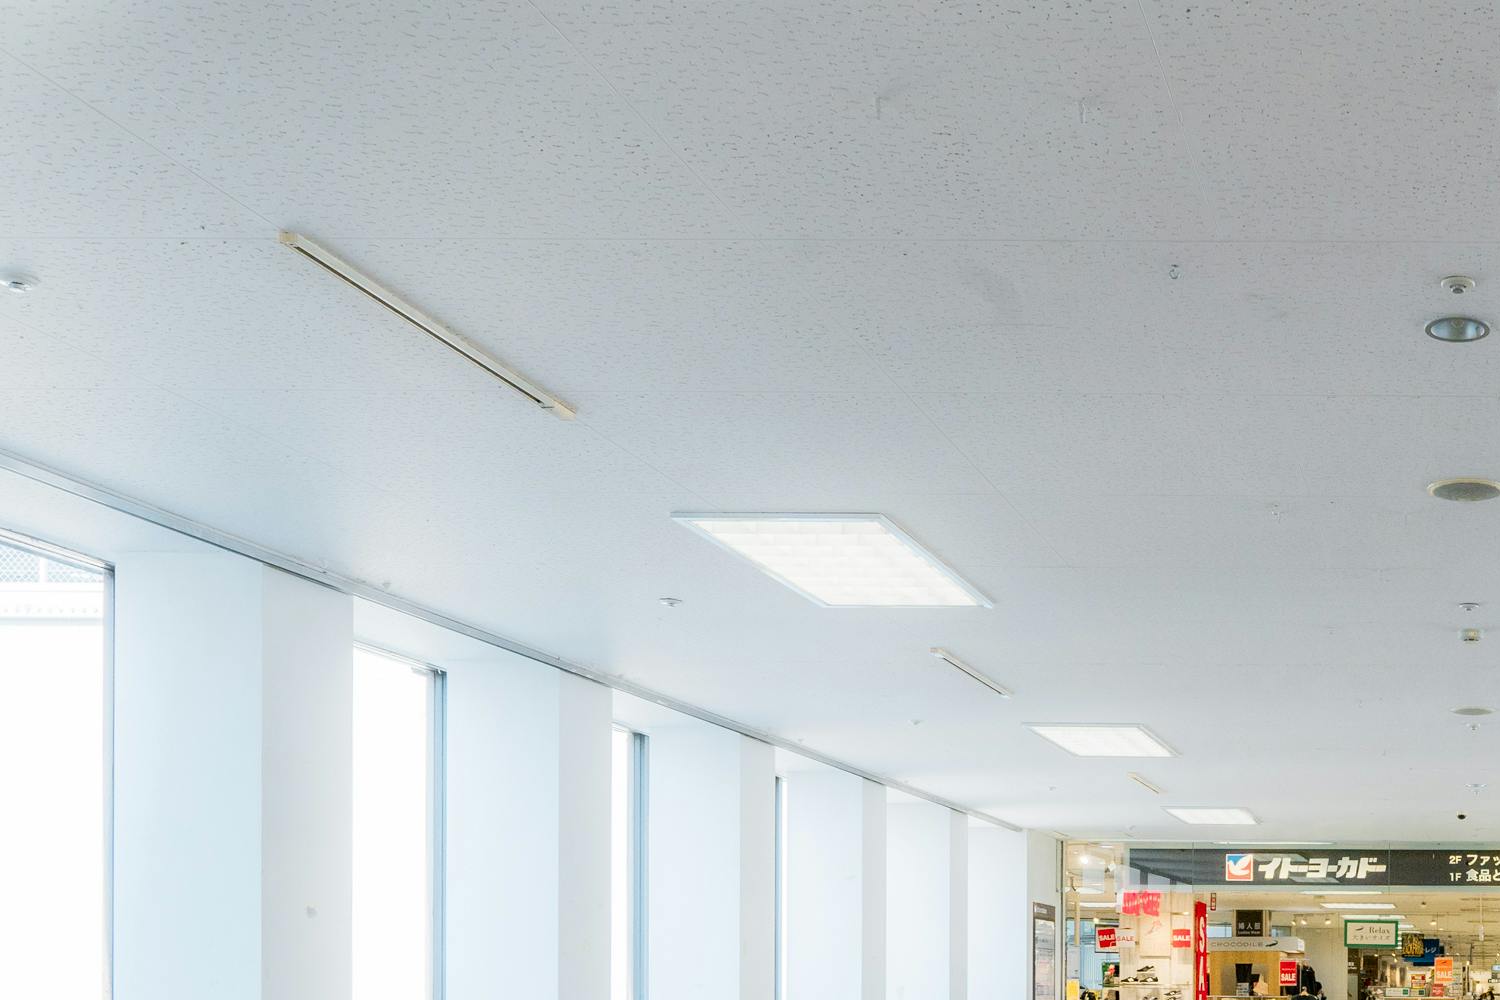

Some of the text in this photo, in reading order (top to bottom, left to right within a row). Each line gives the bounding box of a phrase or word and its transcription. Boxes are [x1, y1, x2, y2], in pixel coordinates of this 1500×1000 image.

[1448, 855, 1462, 865] 2F
[1258, 856, 1387, 880] イトーヨーカドー
[1449, 872, 1462, 882] 1F
[1098, 934, 1116, 942] SALE
[1280, 973, 1296, 981] SALE
